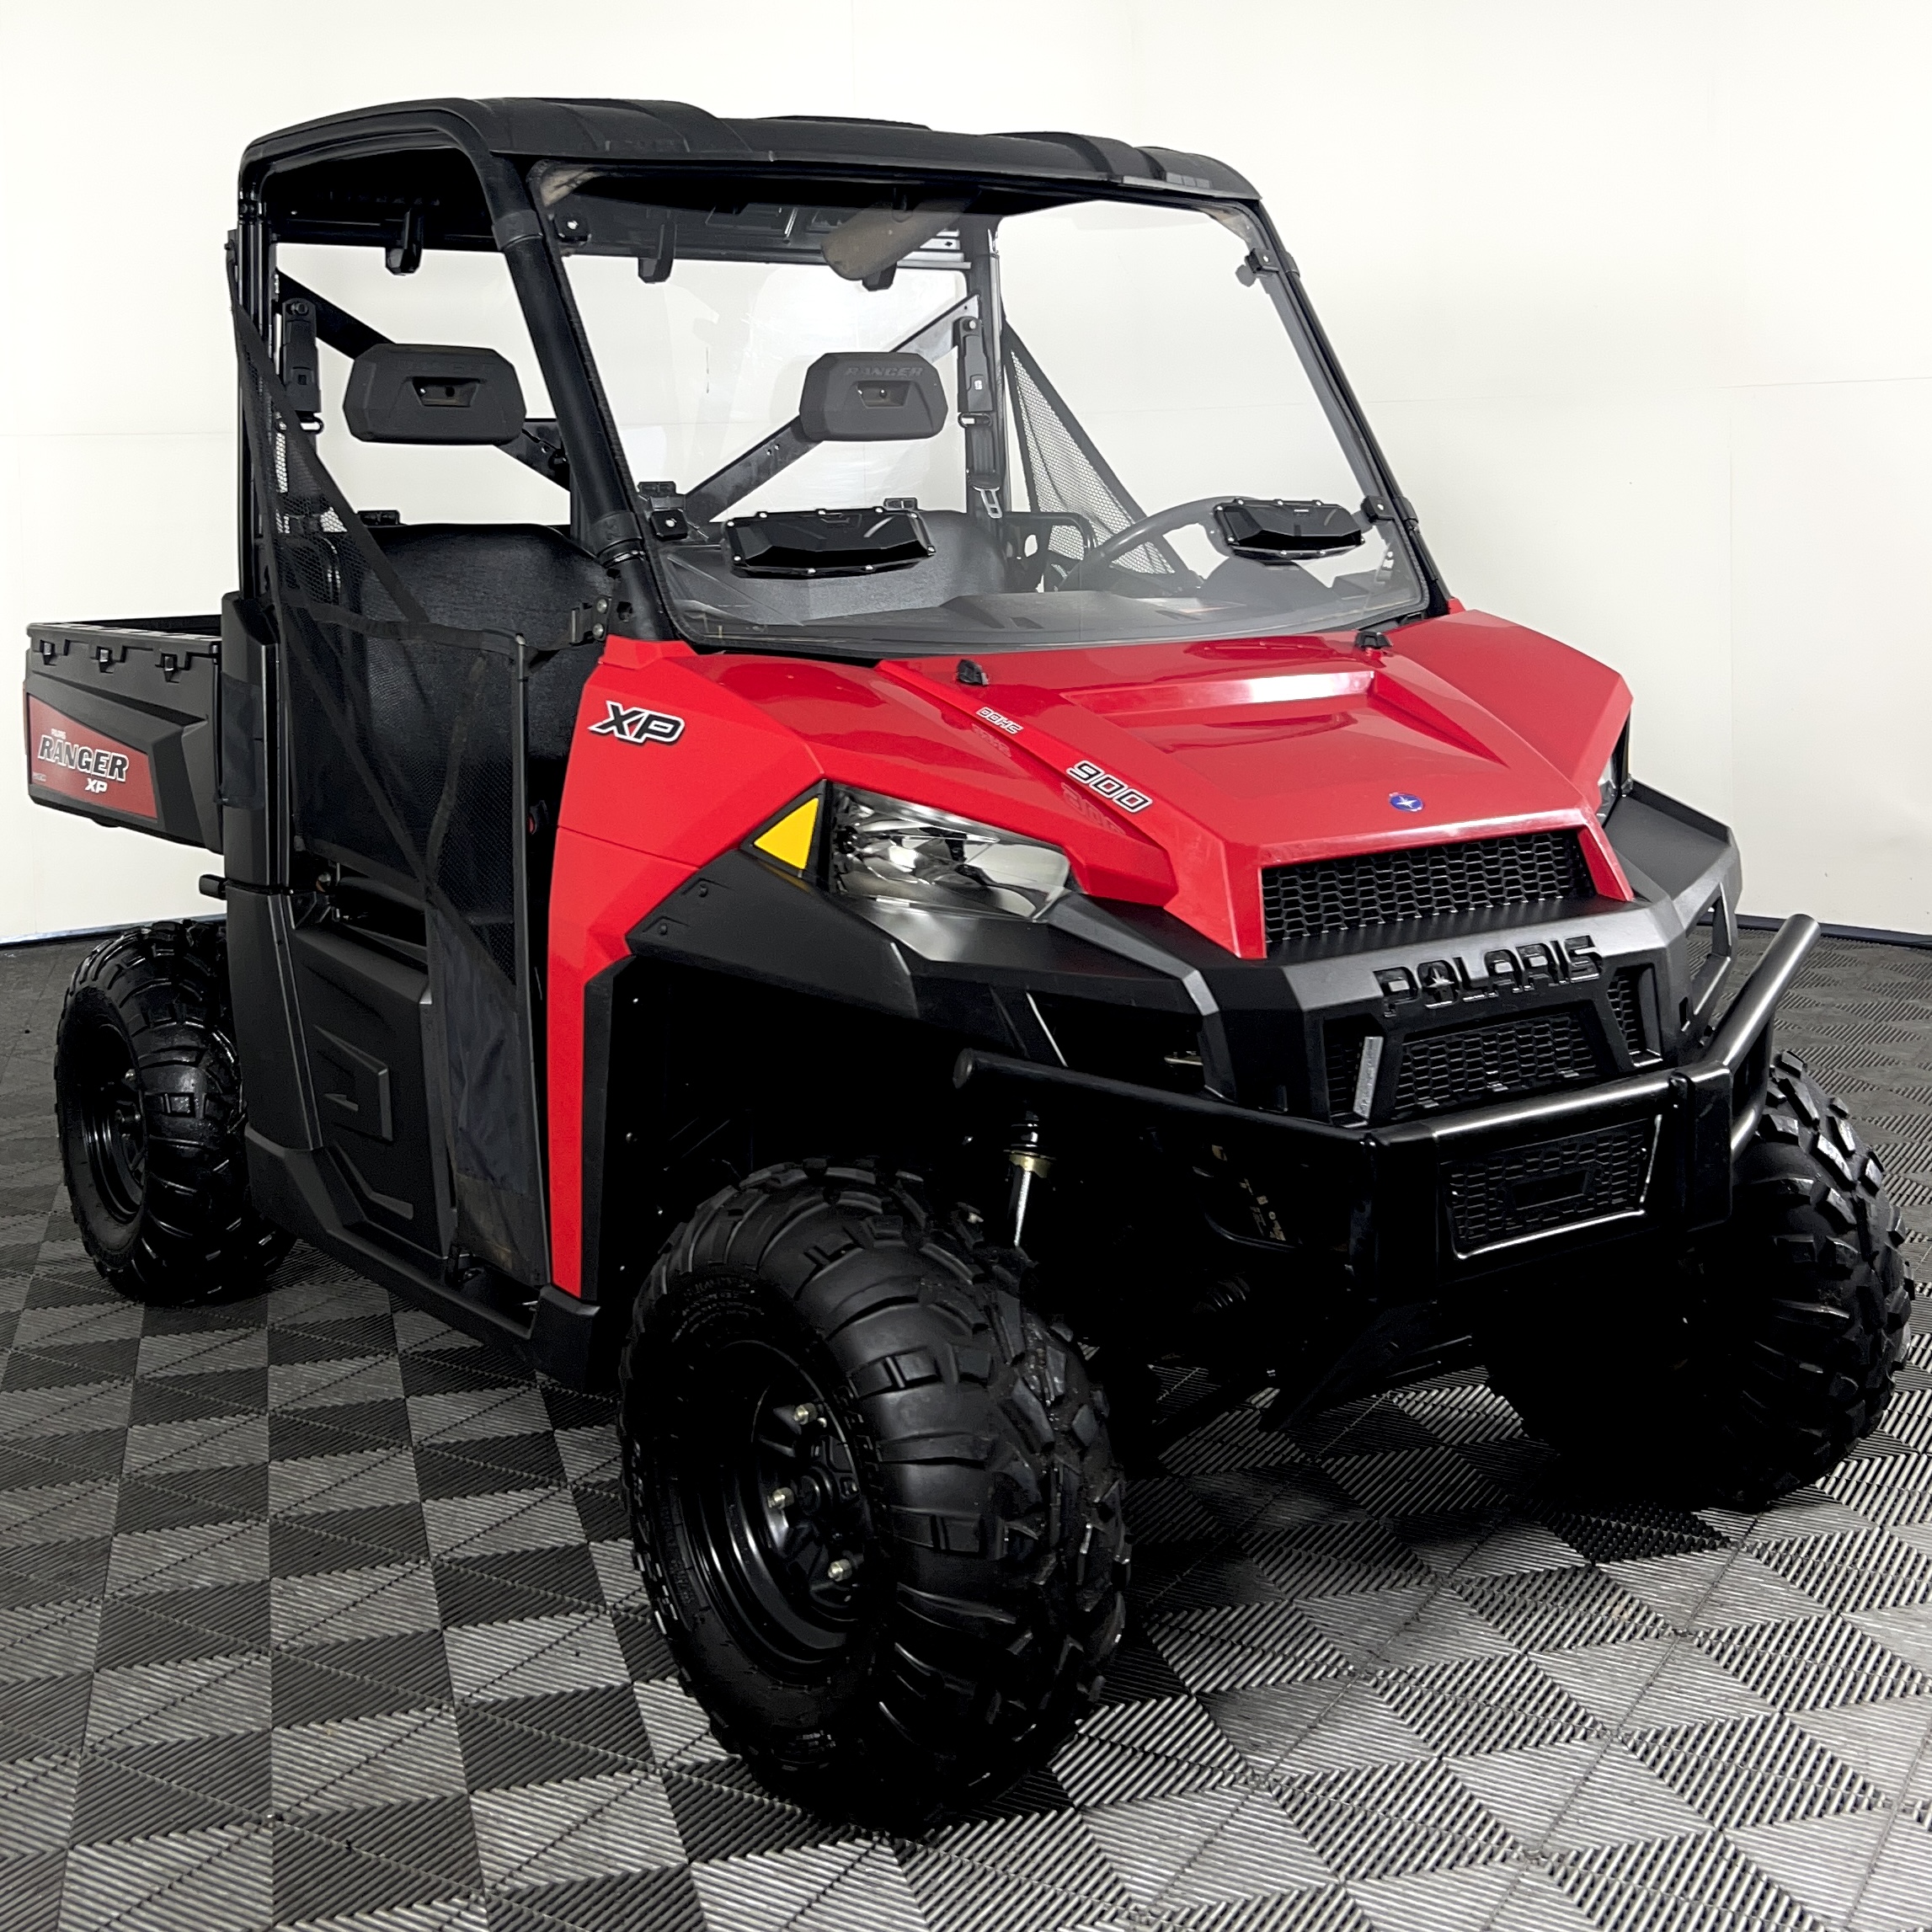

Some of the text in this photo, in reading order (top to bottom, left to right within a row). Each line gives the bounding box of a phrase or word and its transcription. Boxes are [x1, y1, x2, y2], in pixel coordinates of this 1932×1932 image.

[846, 367, 923, 376] RANGER
[587, 700, 685, 745] XP
[38, 734, 129, 782] RANGER
[85, 778, 108, 793] XP
[1065, 760, 1153, 814] 900
[1373, 935, 1603, 1017] POLARIS
